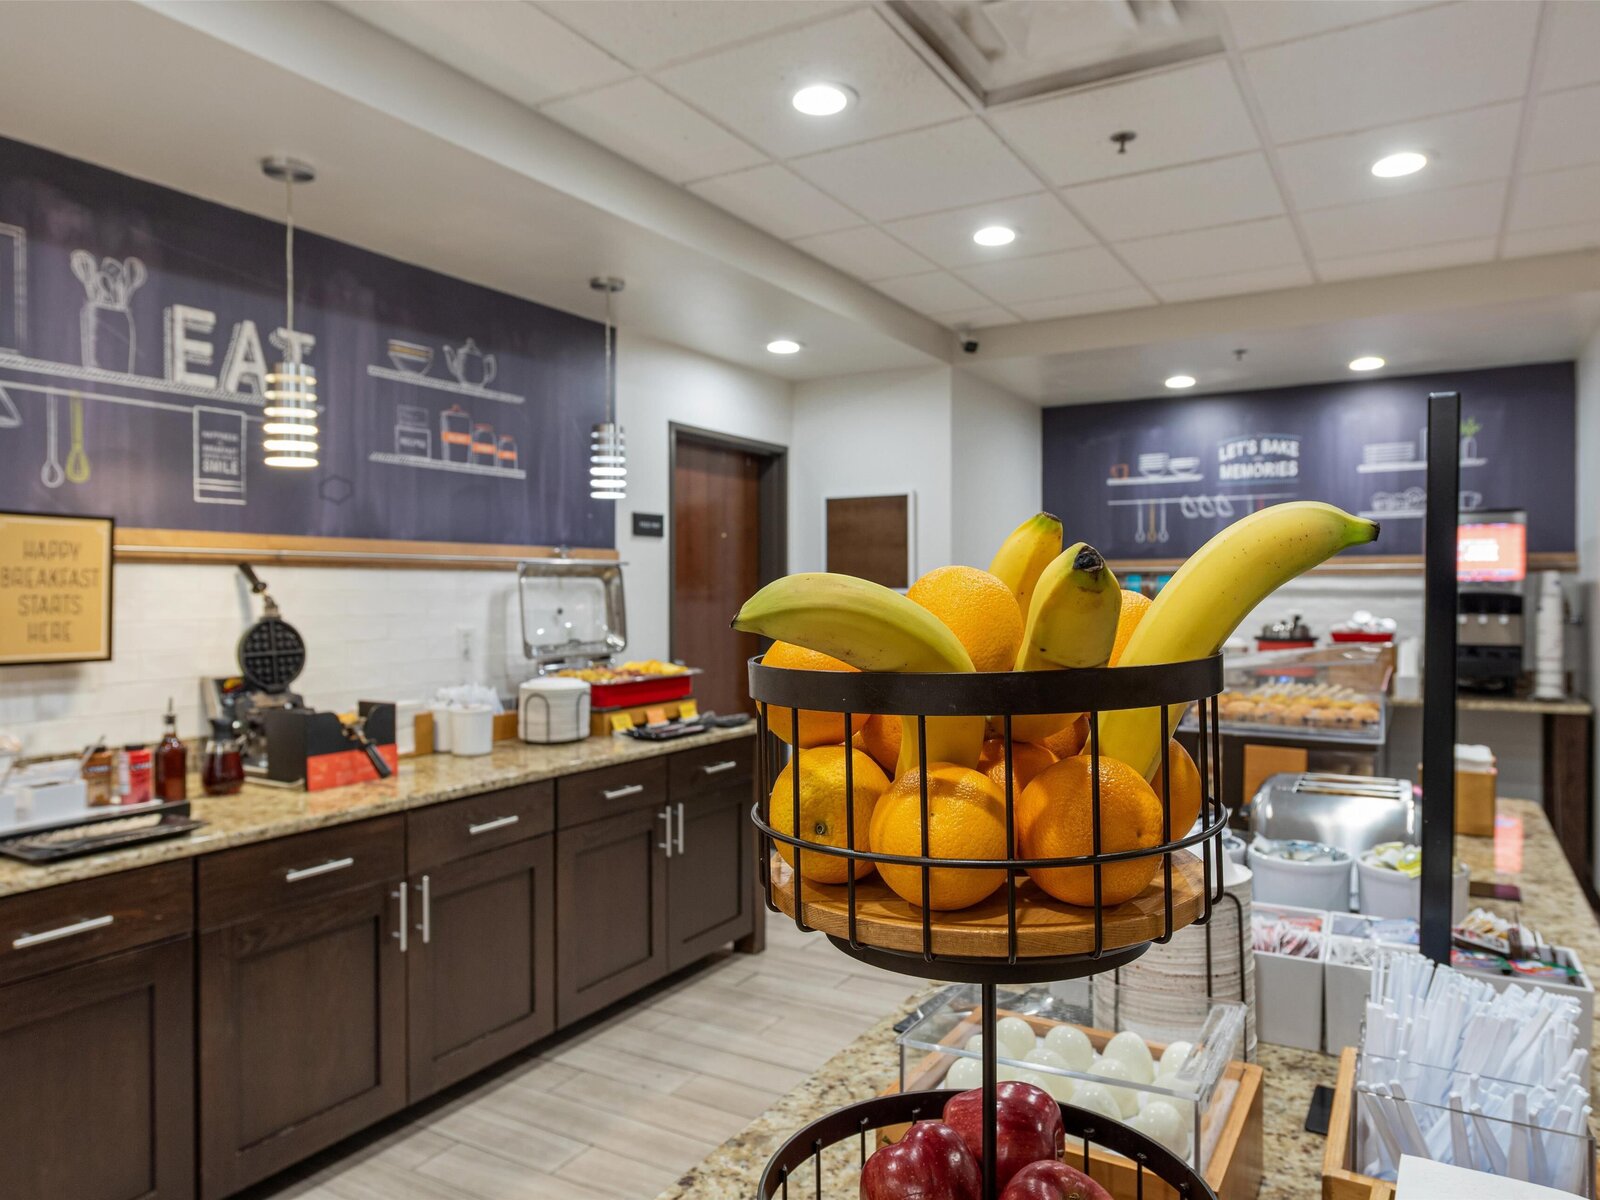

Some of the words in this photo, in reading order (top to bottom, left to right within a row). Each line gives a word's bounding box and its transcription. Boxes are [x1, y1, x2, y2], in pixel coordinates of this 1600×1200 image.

[164, 304, 316, 396] EAT
[1219, 438, 1258, 462] LET'S
[1261, 438, 1300, 458] BAKE
[202, 460, 239, 475] SMILE
[1219, 459, 1299, 480] MEMORIES
[22, 539, 80, 560] HAPPY
[0, 566, 98, 588] BREAKFAST
[18, 594, 81, 616] STARTS
[26, 621, 71, 643] HERE
